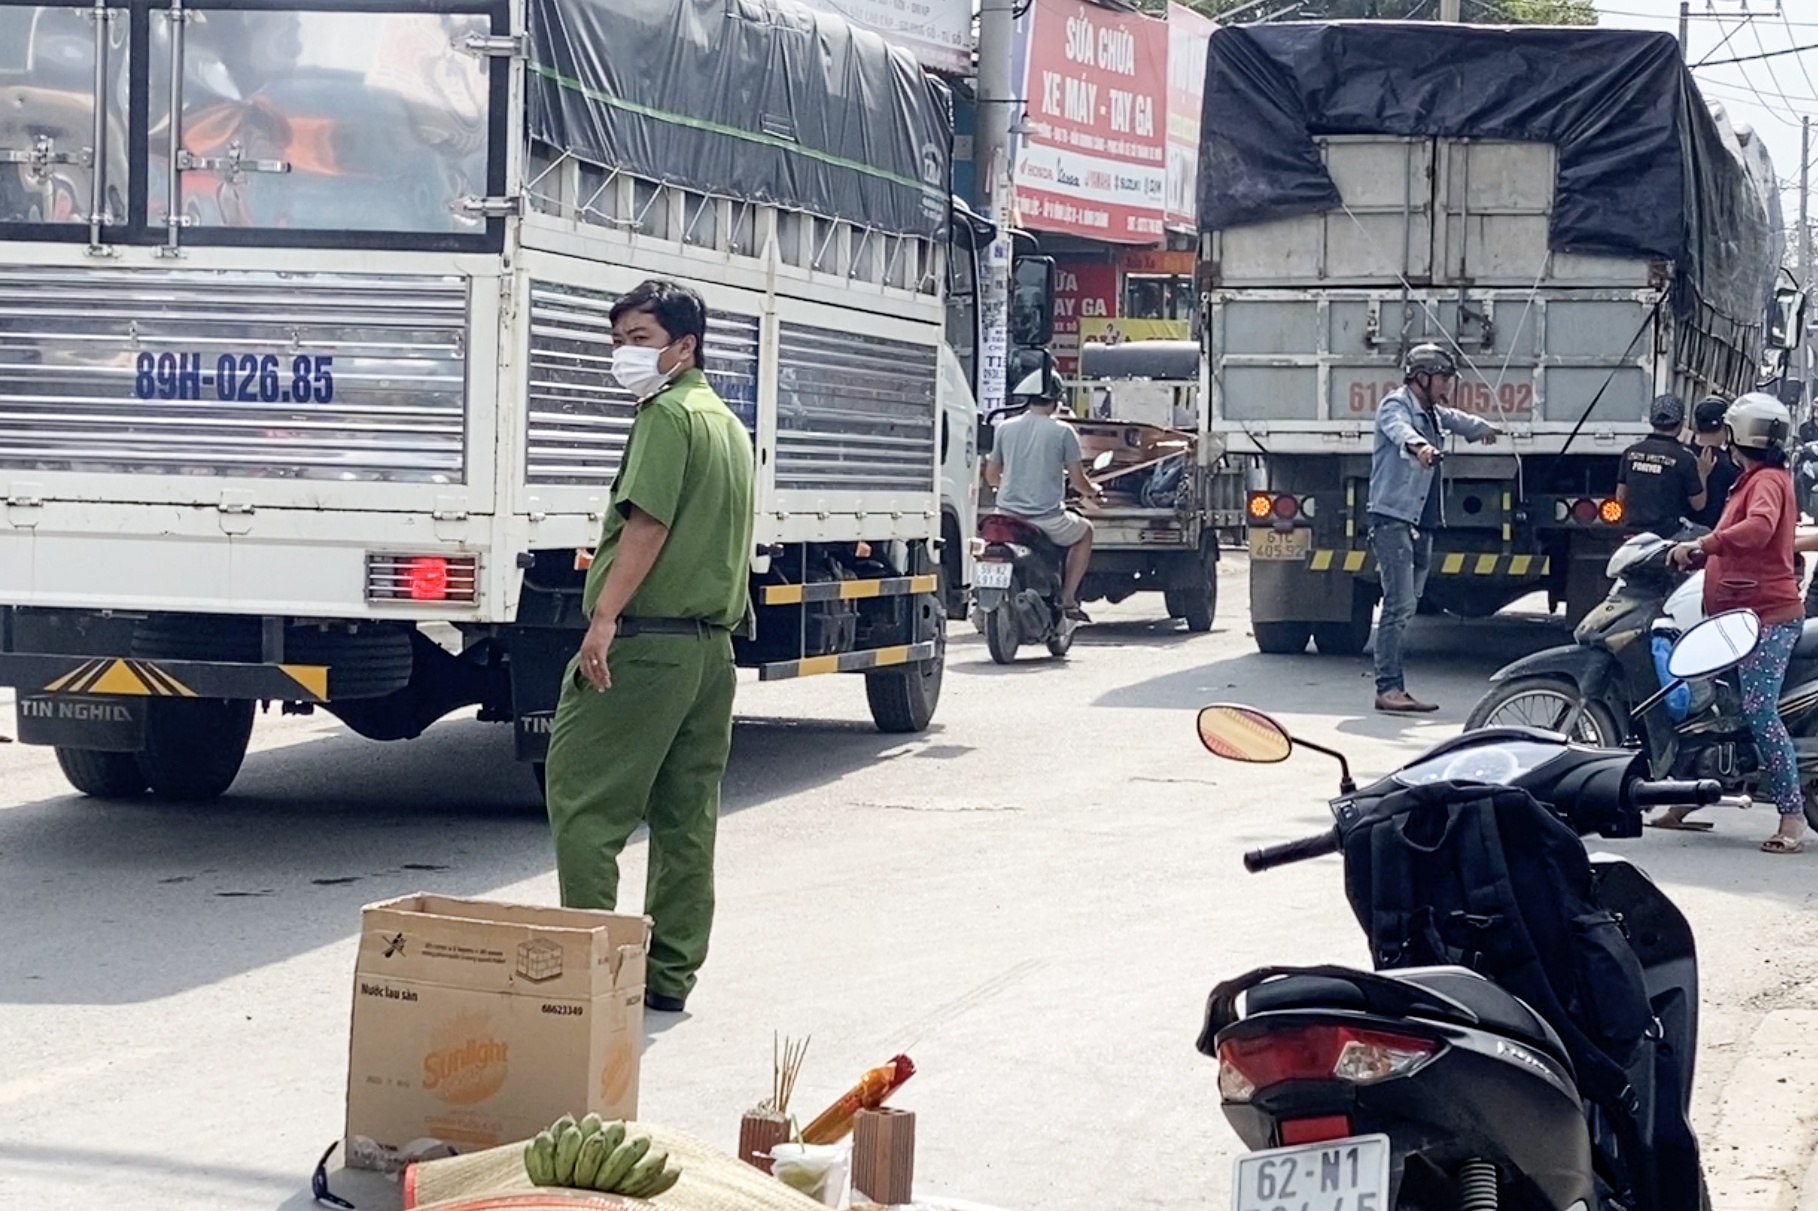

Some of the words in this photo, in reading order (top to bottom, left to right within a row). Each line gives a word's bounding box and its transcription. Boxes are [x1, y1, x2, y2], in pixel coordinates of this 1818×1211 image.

[1065, 6, 1095, 66] SỬA
[1098, 24, 1135, 76] CHỮA
[1041, 70, 1061, 116] XE
[1064, 73, 1097, 125] MÁY
[1109, 88, 1133, 133] TAY
[1135, 94, 1154, 138] GA
[1082, 297, 1108, 316] GA
[135, 351, 333, 404] 89H-026.85
[20, 700, 52, 717] TIN
[520, 716, 555, 733] TIN
[361, 983, 385, 997] Nước
[385, 986, 400, 1000] lau
[401, 989, 418, 1002] sàn
[422, 1038, 509, 1090] Sunlight
[1257, 1147, 1358, 1201] 62-N1
